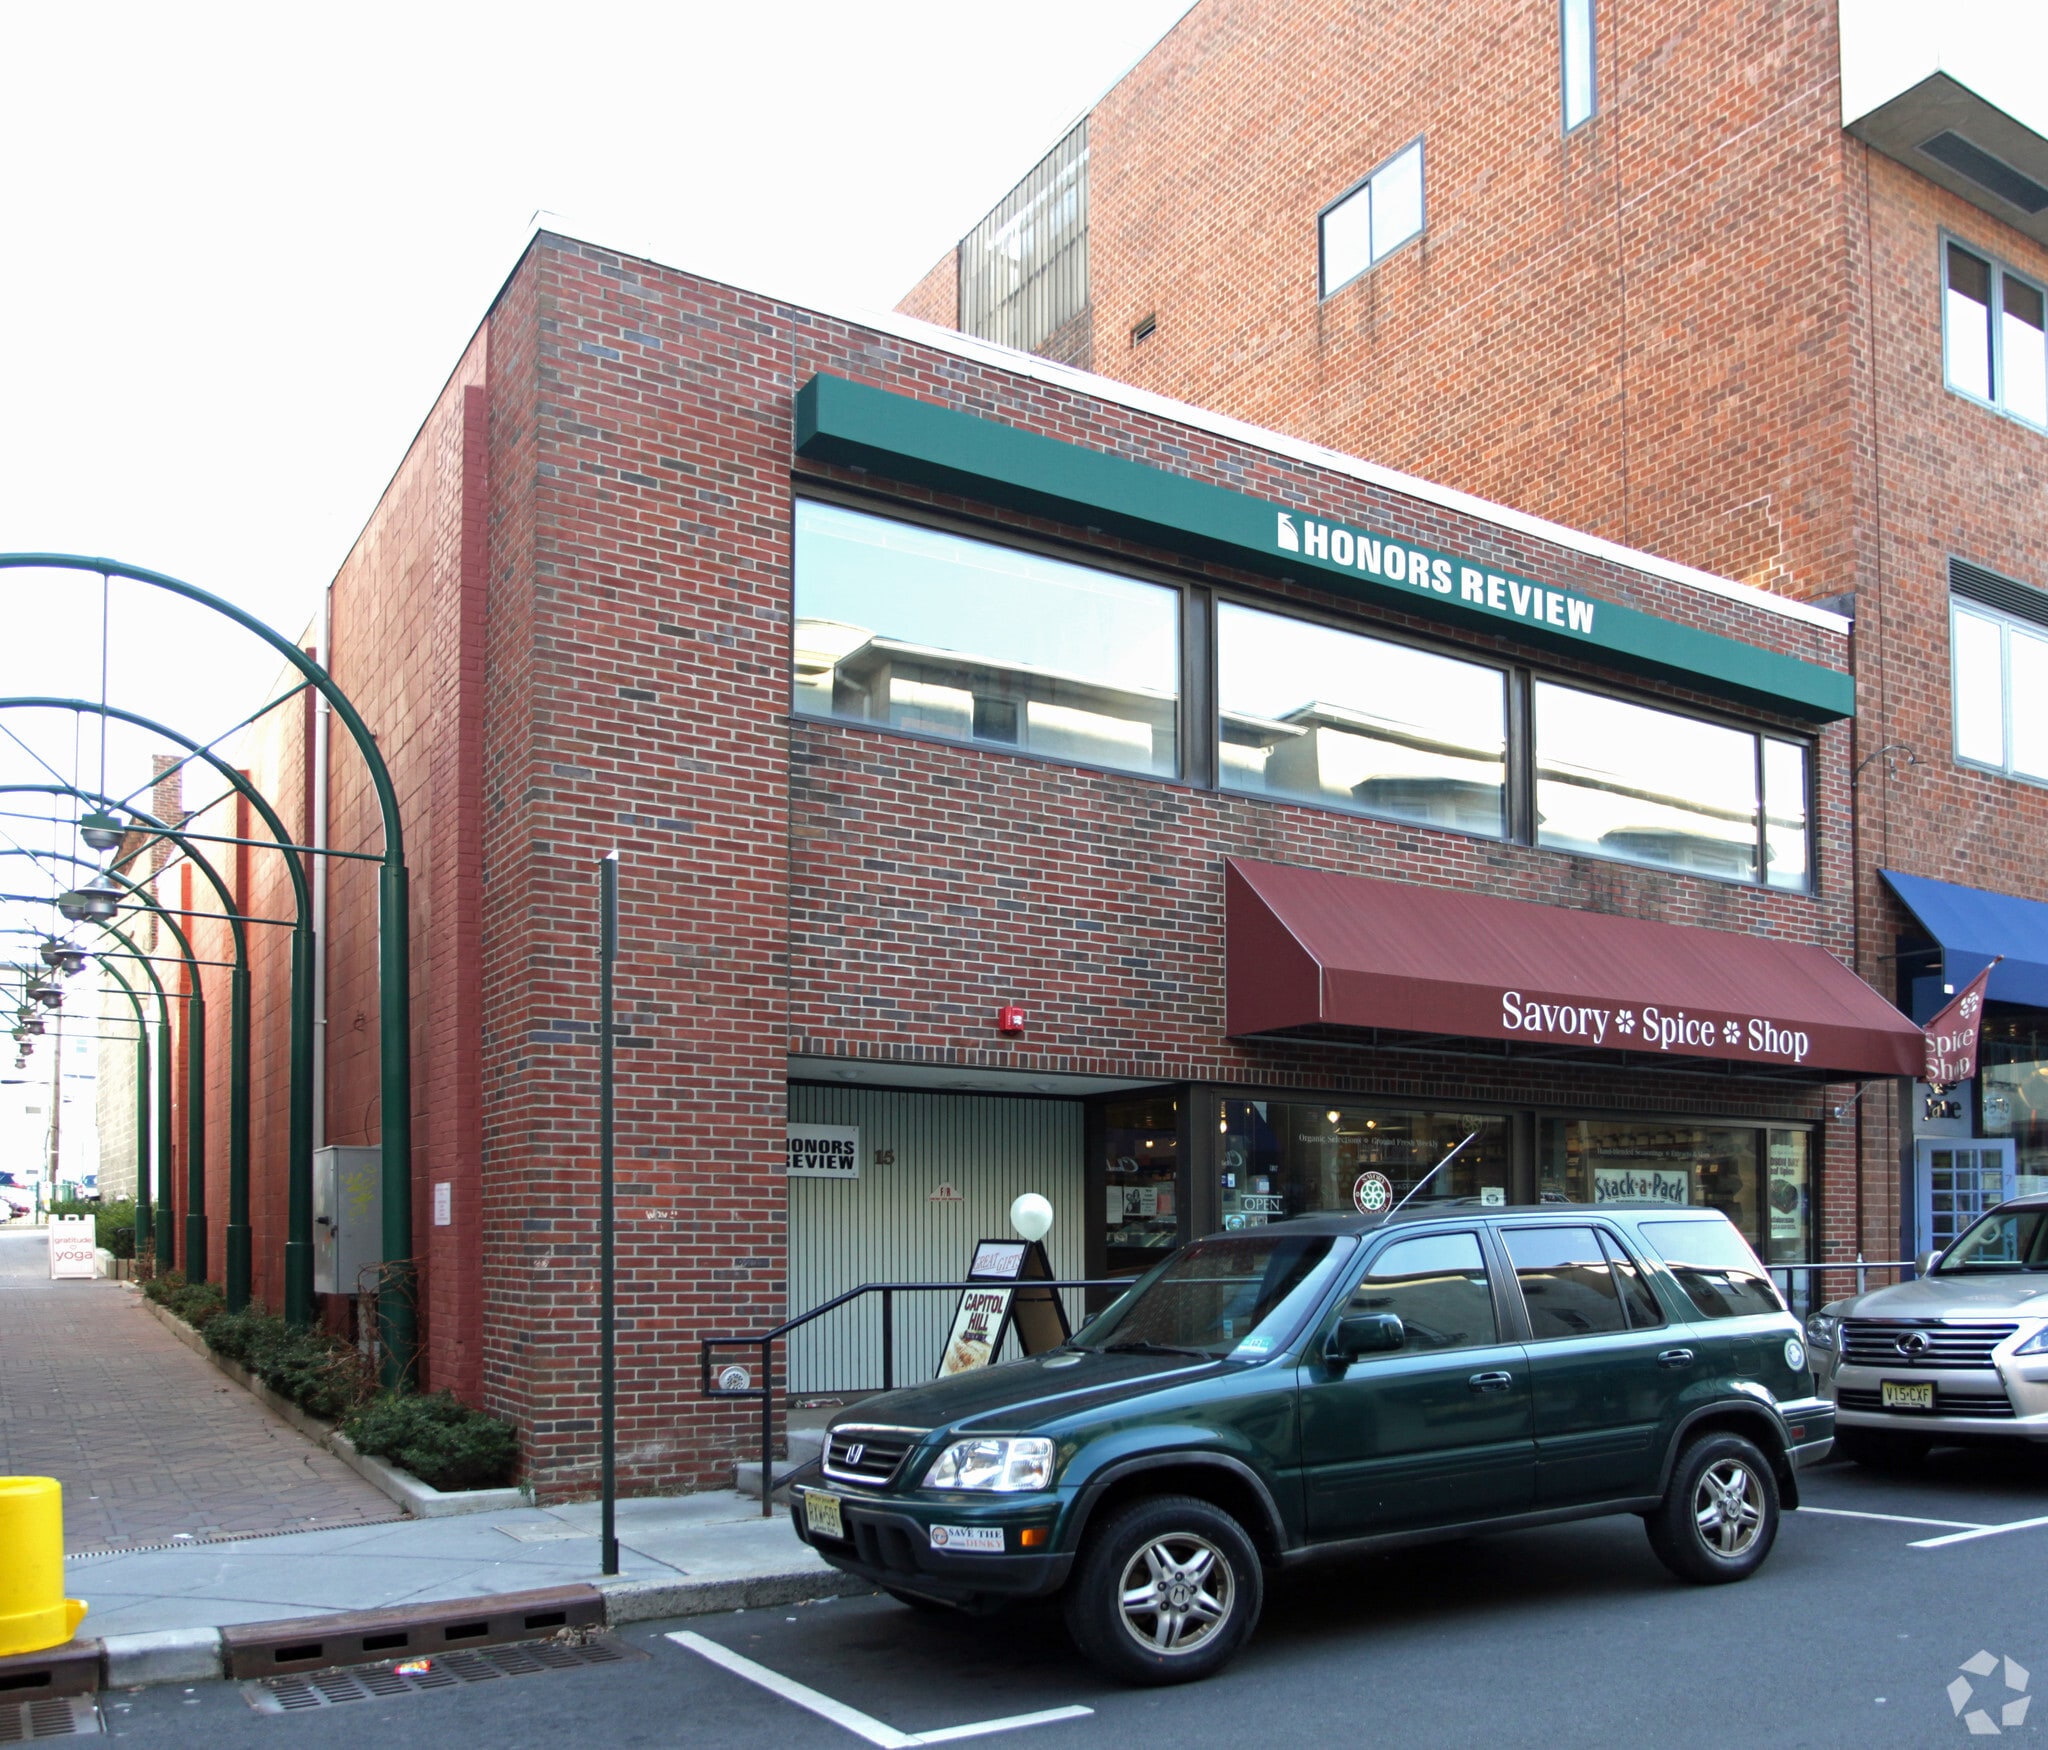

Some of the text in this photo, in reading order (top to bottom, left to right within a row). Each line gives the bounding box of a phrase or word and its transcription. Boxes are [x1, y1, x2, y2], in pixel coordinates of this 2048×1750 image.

[1304, 519, 1595, 634] HONORS REVIEW
[1501, 991, 1809, 1062] Savory Spice Shop
[1925, 1028, 1974, 1057] Spice
[1298, 1134, 1325, 1144] Organic
[875, 1149, 895, 1165] 15
[1244, 1198, 1280, 1211] OPEN
[55, 1251, 93, 1261] yoga
[964, 1293, 1004, 1314] CAPITOL
[967, 1312, 989, 1332] HILL
[948, 1528, 974, 1538] SAVE
[976, 1529, 1002, 1539] THE
[965, 1539, 1003, 1548] DINKY
